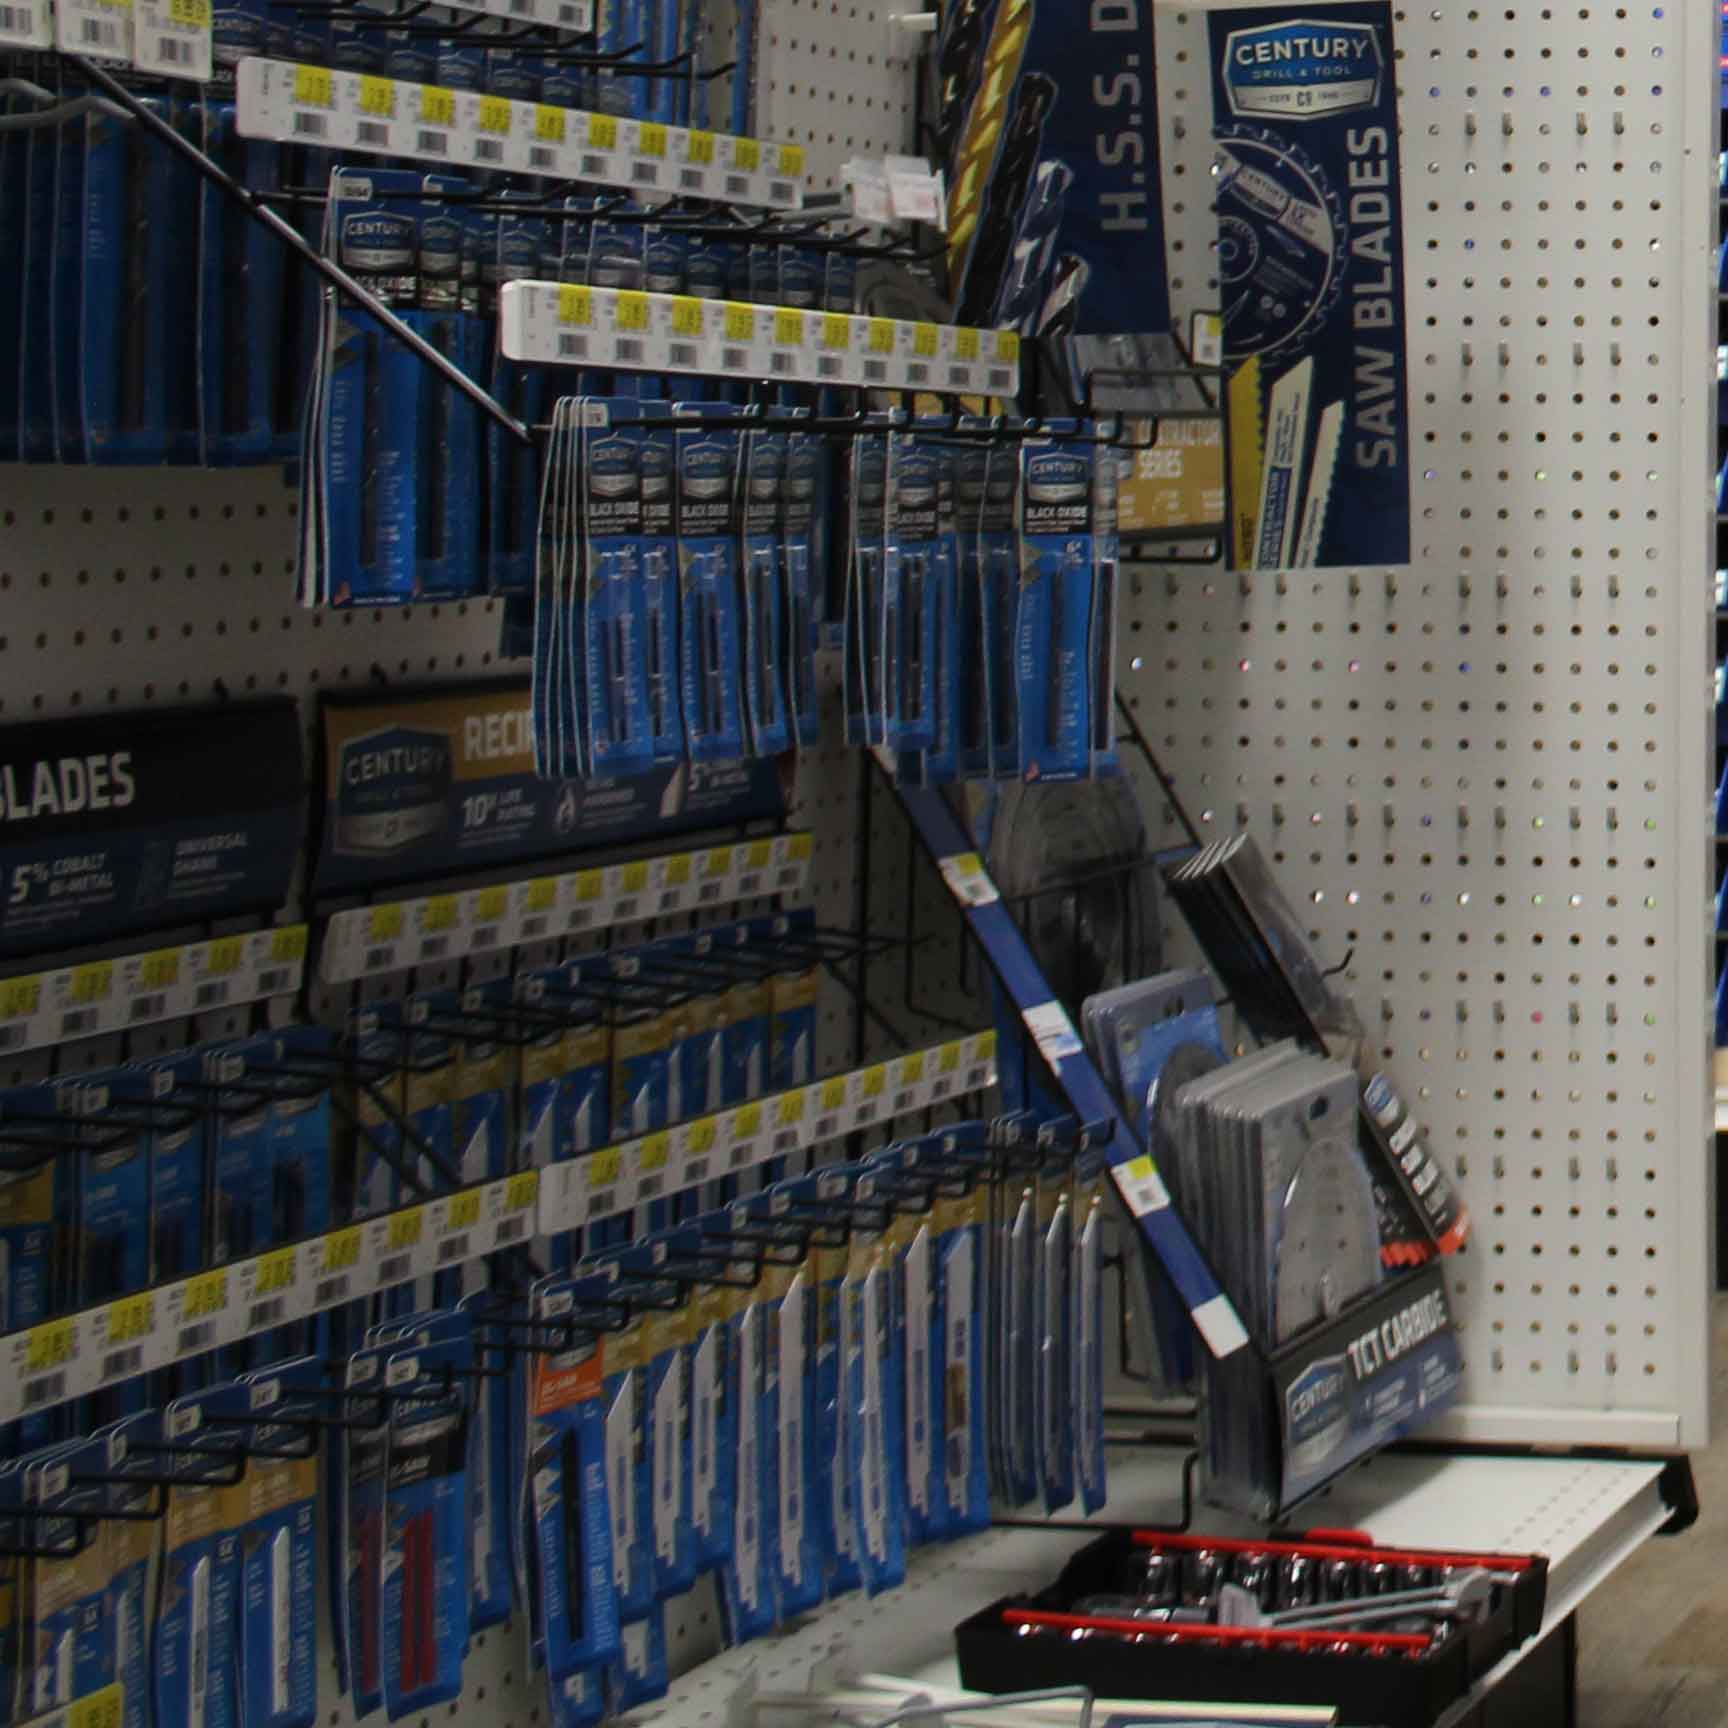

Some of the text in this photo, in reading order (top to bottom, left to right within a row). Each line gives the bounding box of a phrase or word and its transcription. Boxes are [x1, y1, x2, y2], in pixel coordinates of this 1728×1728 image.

[1235, 36, 1370, 66] CENTURY
[1253, 68, 1292, 80] DRILL
[1315, 65, 1352, 76] TOOL
[1097, 52, 1148, 234] H.S.S.
[1346, 124, 1398, 470] SAW BLADES
[1026, 506, 1056, 522] BLACK
[346, 745, 447, 784] CENTURY
[1346, 1286, 1448, 1381] TCT CARBIDE
